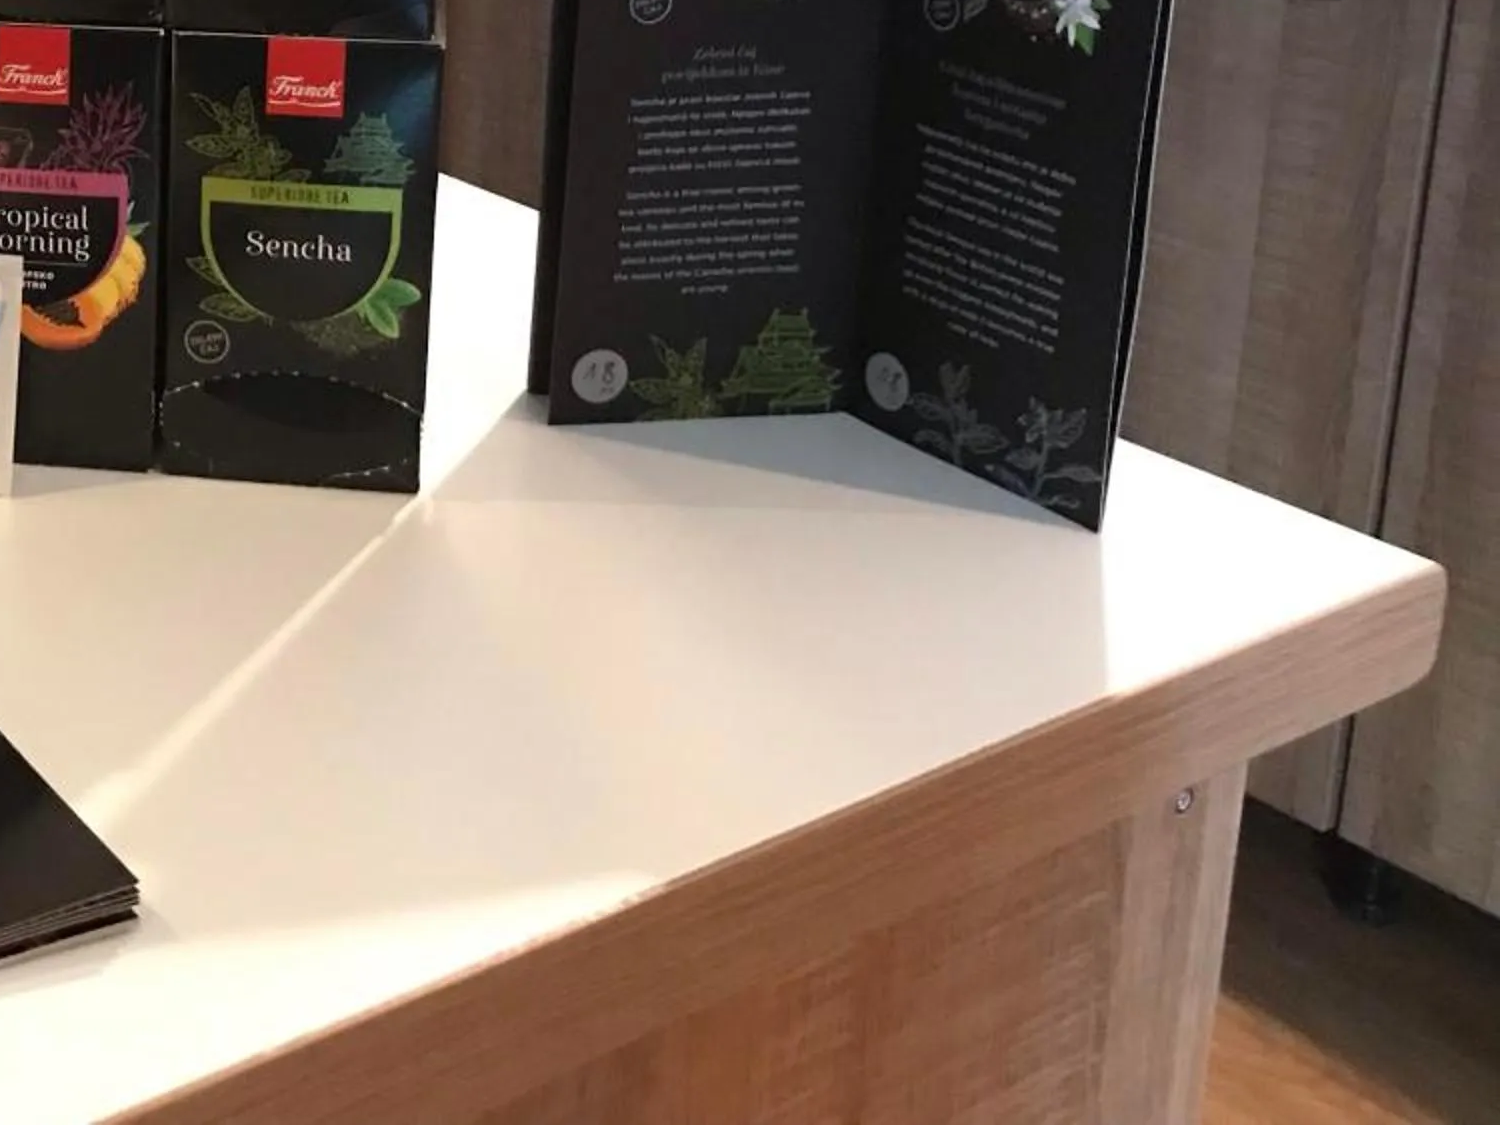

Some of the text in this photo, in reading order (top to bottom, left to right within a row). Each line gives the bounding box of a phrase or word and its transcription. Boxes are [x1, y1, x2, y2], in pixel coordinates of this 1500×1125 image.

[268, 75, 343, 100] Franck
[53, 175, 78, 190] TEA
[326, 188, 350, 205] TEA
[244, 230, 353, 263] Sencha
